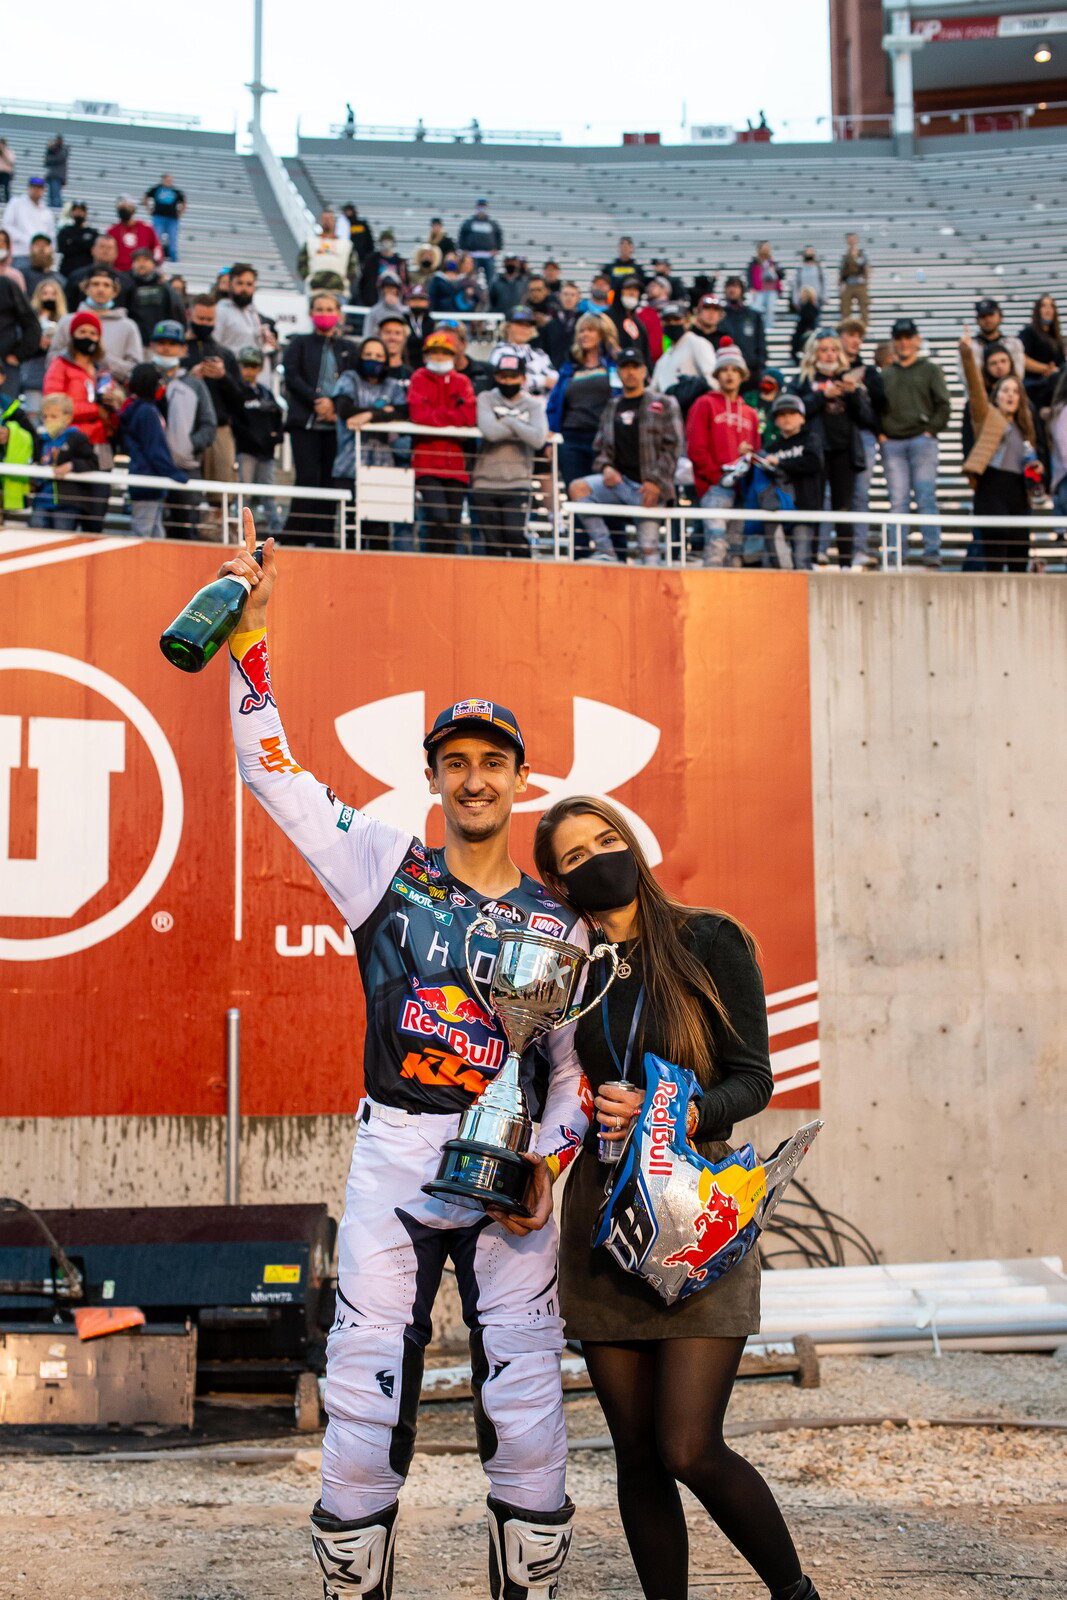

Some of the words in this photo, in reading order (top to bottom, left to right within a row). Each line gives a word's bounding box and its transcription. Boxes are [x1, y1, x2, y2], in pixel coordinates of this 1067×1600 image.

[481, 900, 521, 922] Airoh
[533, 917, 562, 937] 100%
[275, 924, 356, 957] UN
[448, 1027, 504, 1069] Bull
[652, 1079, 678, 1126] Red
[649, 1127, 675, 1177] Bull
